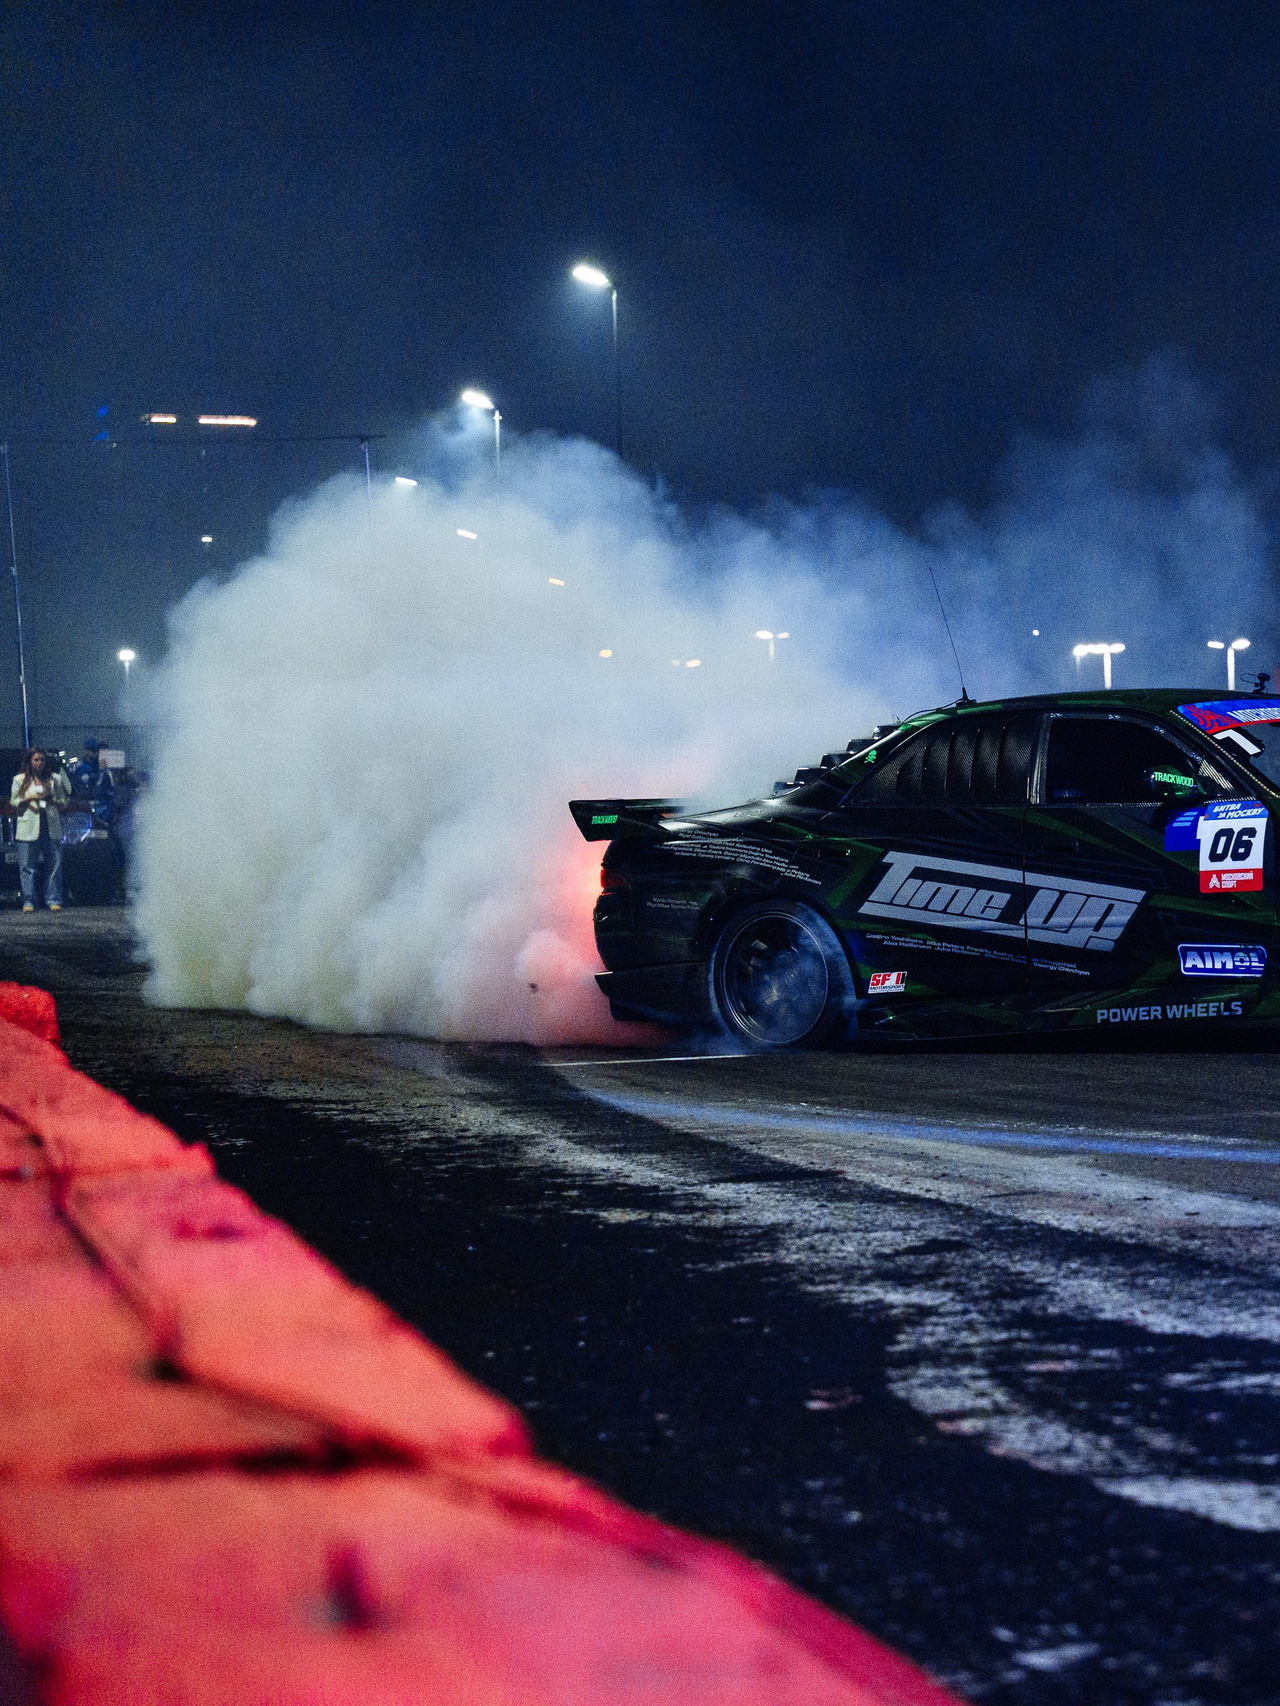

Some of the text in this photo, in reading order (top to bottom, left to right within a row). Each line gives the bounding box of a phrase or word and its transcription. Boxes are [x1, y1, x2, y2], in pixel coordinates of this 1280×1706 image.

[1213, 803, 1241, 813] БИТВА
[1226, 807, 1265, 819] МОСКВУ
[1208, 827, 1258, 862] 06
[1185, 951, 1265, 970] AIMOL
[1097, 1001, 1243, 1023] POWER WHEELS
